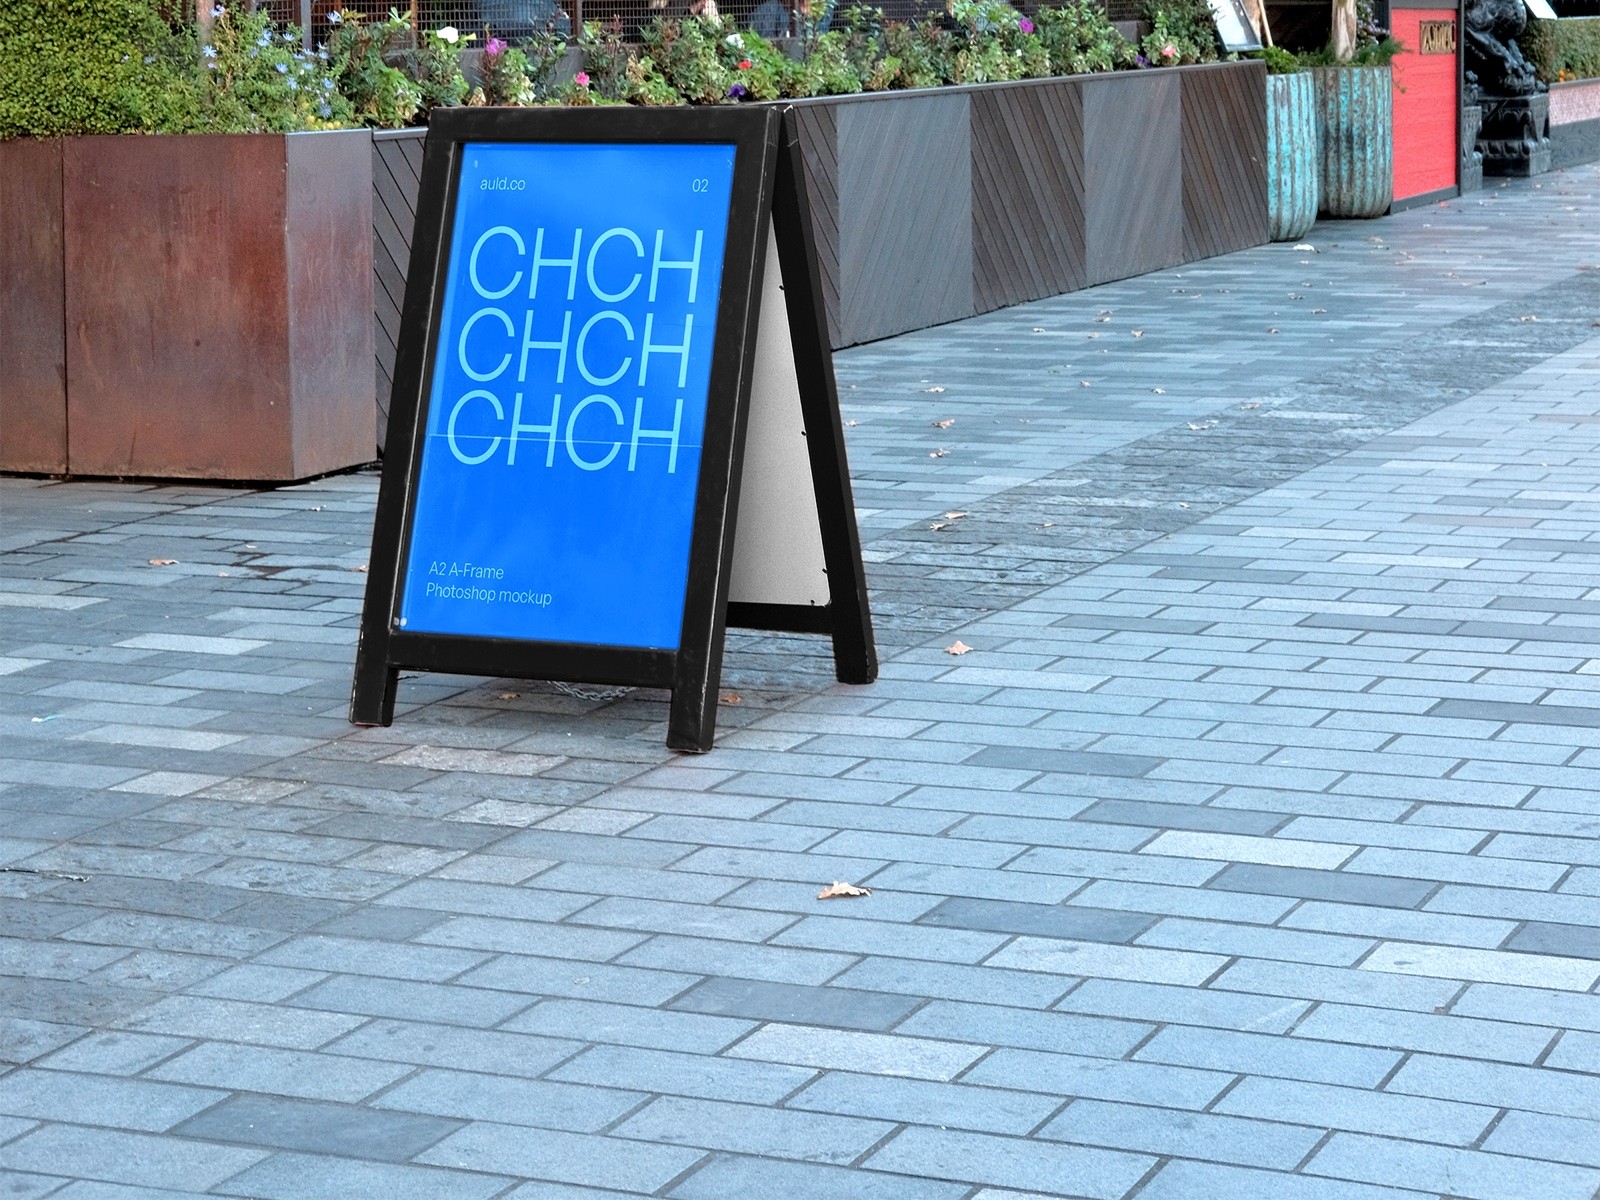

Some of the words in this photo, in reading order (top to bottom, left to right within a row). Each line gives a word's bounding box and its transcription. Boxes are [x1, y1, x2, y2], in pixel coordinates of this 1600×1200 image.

[479, 176, 526, 191] auld.co
[691, 178, 709, 193] 02
[469, 225, 704, 303] CHCH
[458, 307, 694, 388] CHCH
[447, 389, 684, 474] CHCH
[426, 582, 497, 604] Photoshop
[498, 589, 552, 608] mockup
[428, 560, 447, 576] A2
[448, 562, 504, 580] A-Frame
